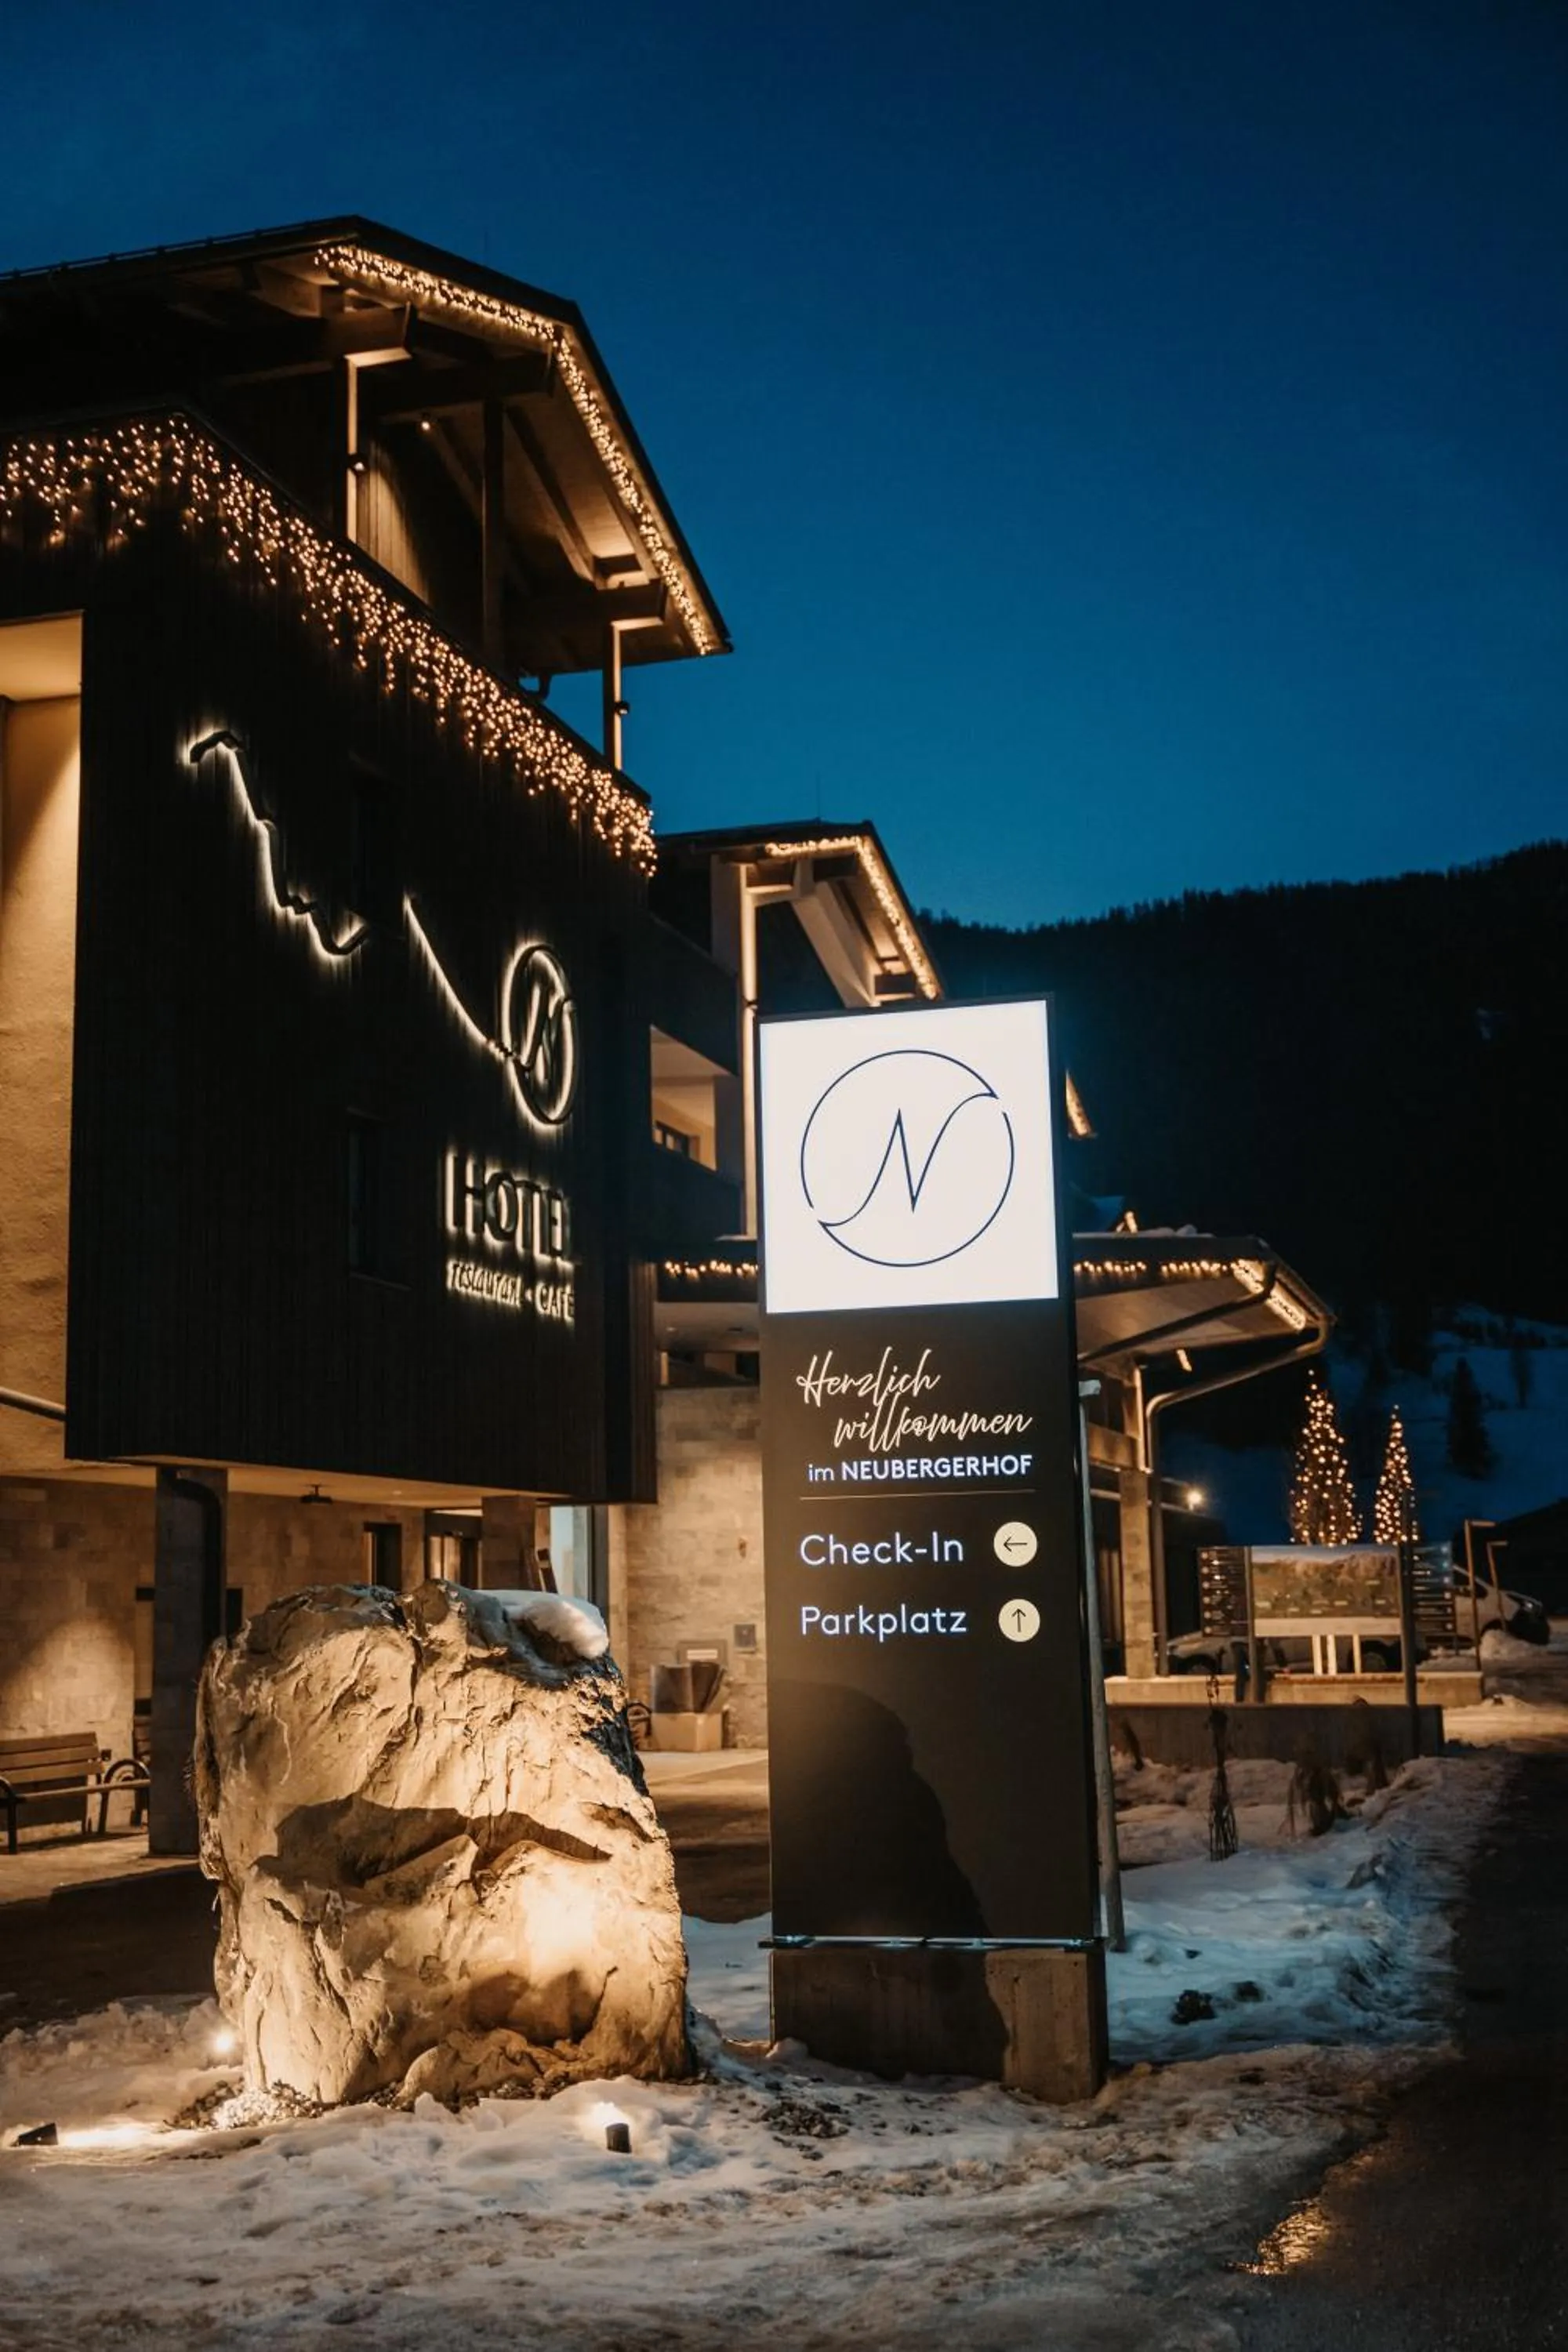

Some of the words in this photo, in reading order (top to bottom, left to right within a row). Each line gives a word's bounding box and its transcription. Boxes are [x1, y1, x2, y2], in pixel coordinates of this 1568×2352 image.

[445, 1151, 575, 1266] HOTEL
[796, 1345, 941, 1407] Herzlich
[833, 1392, 1033, 1452] willkommen
[808, 1464, 834, 1482] im
[842, 1455, 1033, 1481] NEUBERGERHOF
[800, 1531, 964, 1566] Check-In
[801, 1604, 967, 1642] Parkplatz
